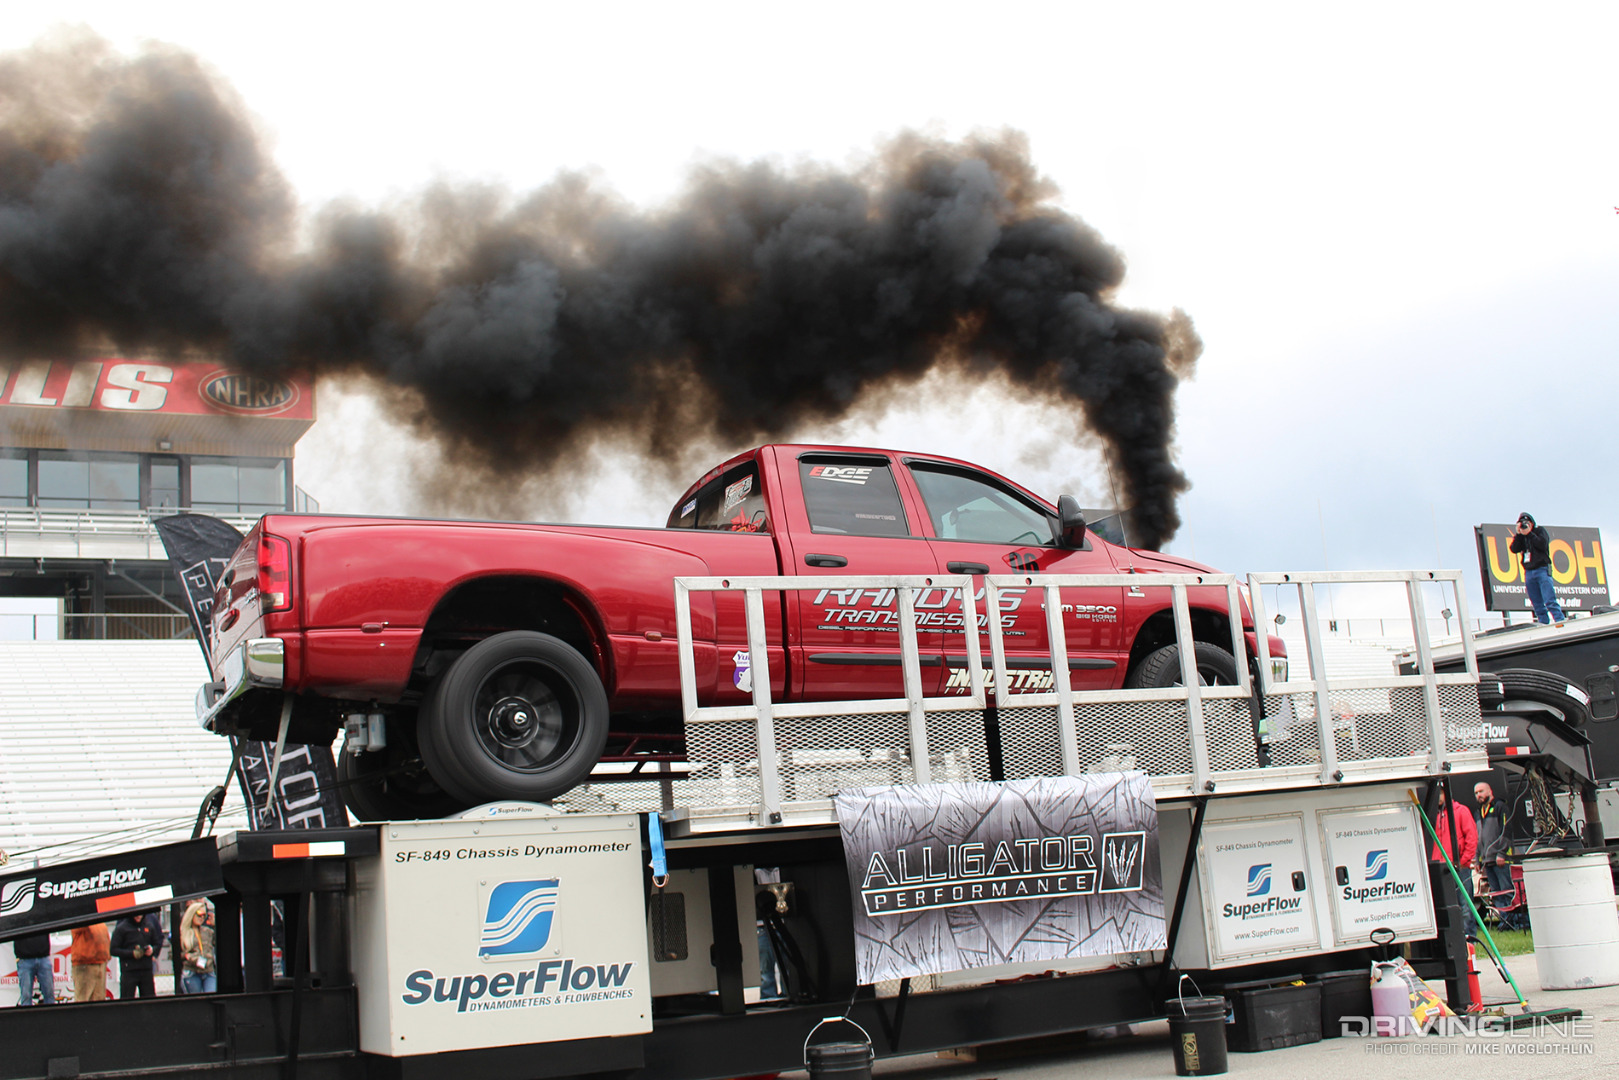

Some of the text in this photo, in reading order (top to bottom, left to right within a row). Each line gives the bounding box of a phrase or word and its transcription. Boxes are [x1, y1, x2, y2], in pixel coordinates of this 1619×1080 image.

[215, 377, 285, 407] NHRA
[808, 466, 873, 480] EDGE
[1487, 535, 1606, 585] UOH
[813, 588, 1027, 611] RADYS
[1493, 585, 1527, 594] UNIVERSIT
[1591, 587, 1607, 595] OHIO
[824, 609, 1018, 628] TRANSISSS
[1075, 605, 1117, 613] 3500
[1329, 620, 1338, 631] H
[1447, 722, 1510, 743] SuperFlow
[1353, 829, 1373, 837] Chassis
[1374, 826, 1407, 836] Dynamometer
[395, 841, 632, 863] SF-849 Chassis Dynamometer
[1235, 841, 1257, 850] Chassis
[1257, 838, 1294, 848] Dynamometer
[862, 834, 1097, 888] ALLIGATOR
[38, 867, 145, 899] SuperFlow
[875, 875, 1087, 910] PERFORMANCE
[1343, 882, 1416, 903] SuperFlow
[1223, 896, 1301, 920] SuperFlow
[1354, 910, 1414, 924] www.SuperFlow.com
[1234, 926, 1300, 940] www.SuperFlow.com
[1, 976, 19, 985] DIESE
[402, 959, 633, 1013] SuperFlow
[470, 989, 634, 1012] DYNAMOMETERS & FLOWBENCHES
